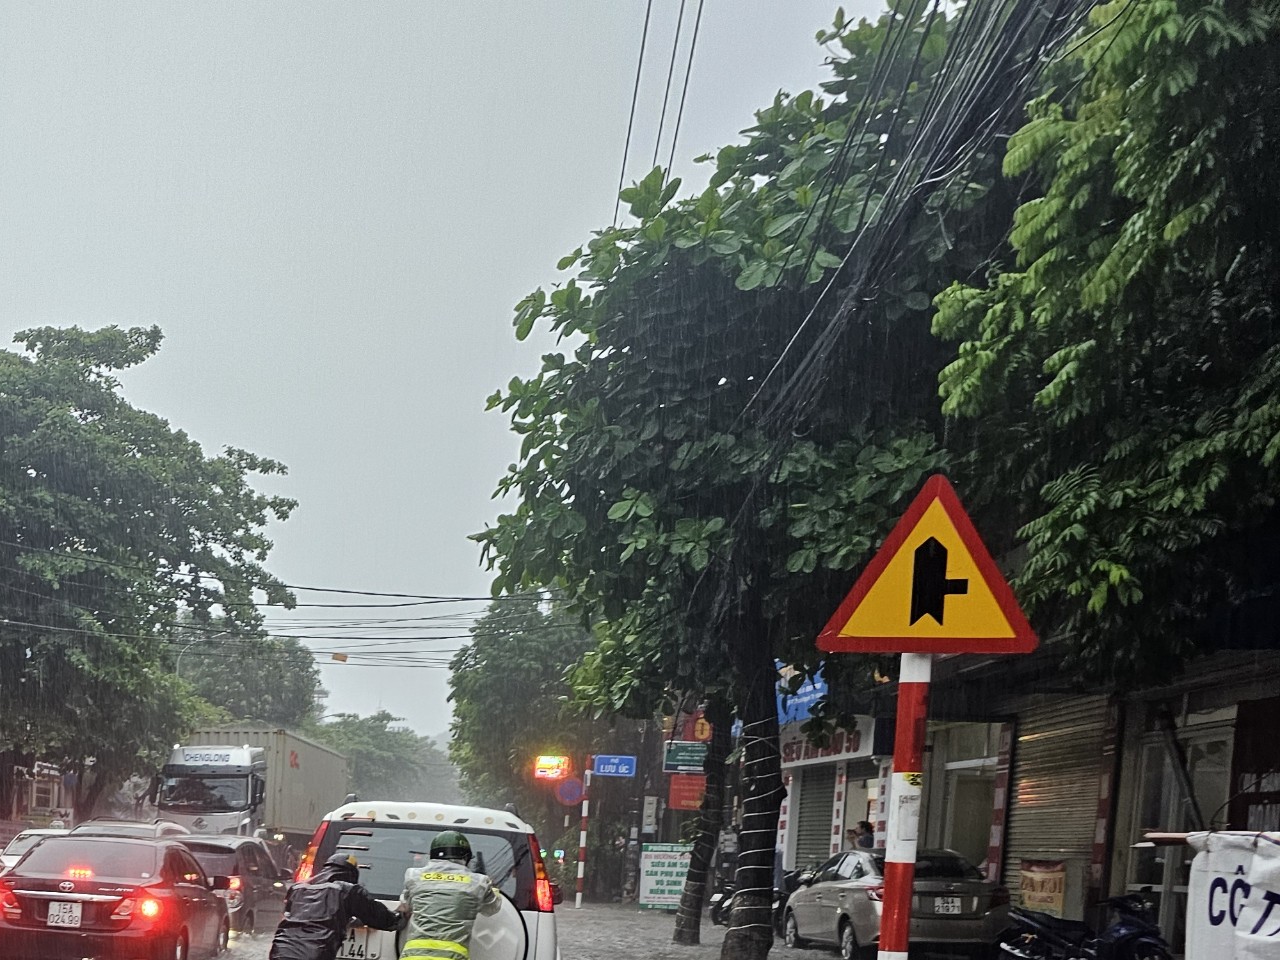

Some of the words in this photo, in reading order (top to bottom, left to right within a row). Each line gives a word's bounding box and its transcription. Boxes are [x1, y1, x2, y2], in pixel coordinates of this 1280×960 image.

[184, 753, 231, 763] CHENGLONG
[423, 873, 465, 882] C.S.G.T
[57, 903, 74, 915] 15A
